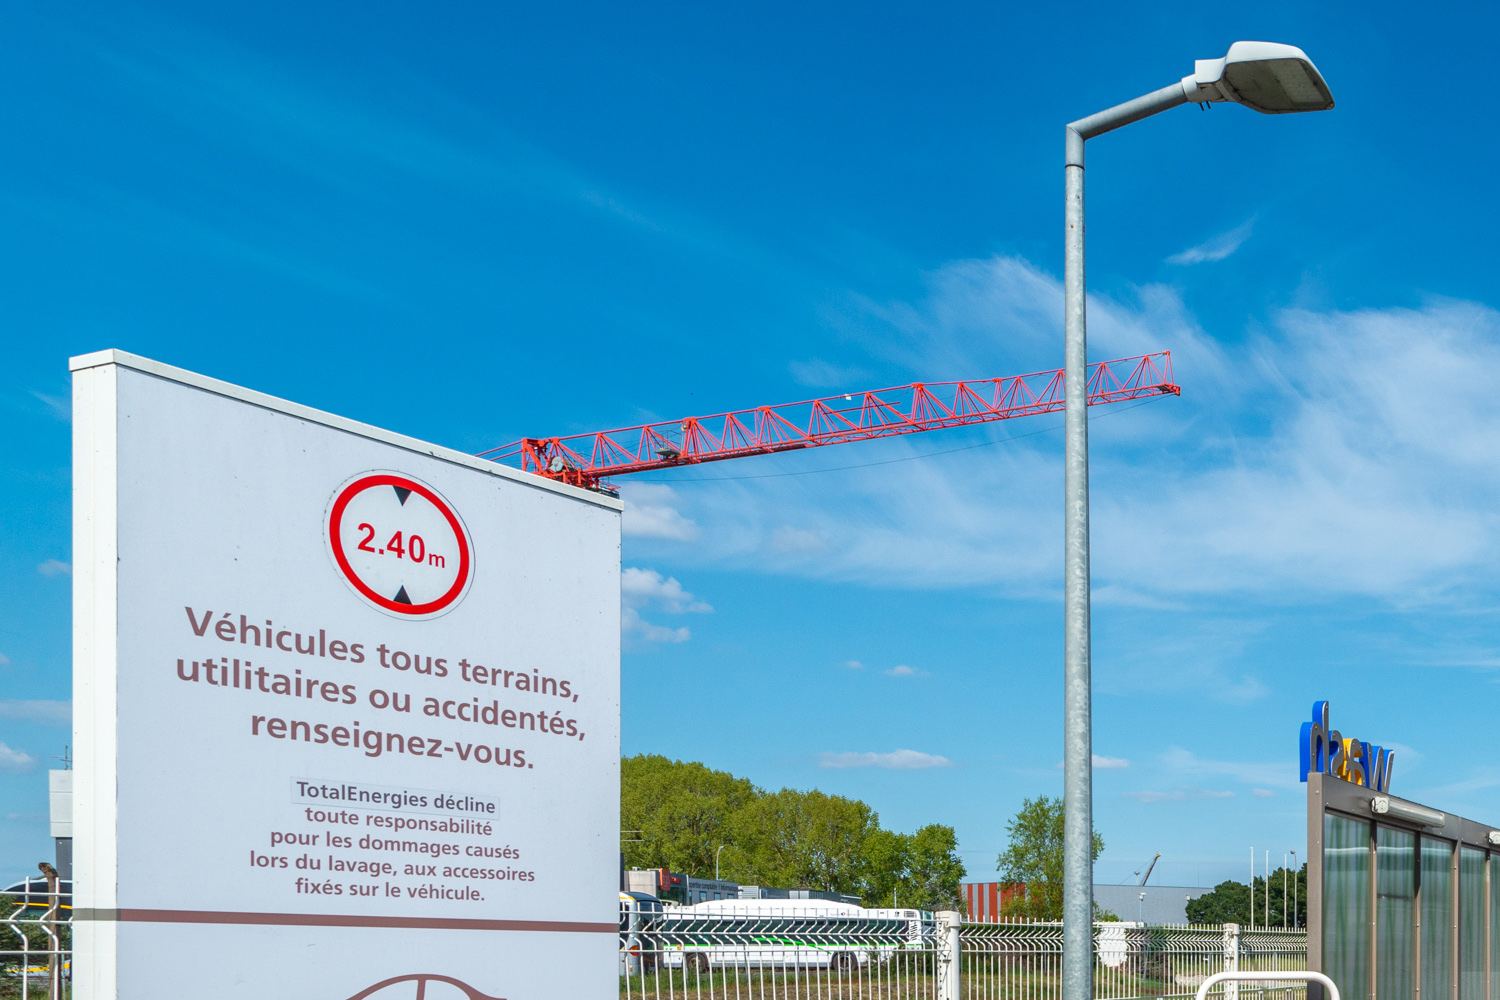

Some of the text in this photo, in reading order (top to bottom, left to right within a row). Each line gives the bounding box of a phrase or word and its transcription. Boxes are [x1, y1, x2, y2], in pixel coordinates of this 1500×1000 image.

[357, 523, 445, 569] 2.40m
[185, 606, 580, 701] Véhicules tous terrains,
[177, 658, 585, 741] utilitaires ou accidentés,
[252, 714, 533, 769] renseignez-vous.
[297, 781, 495, 814] TotalEnergies décline
[305, 807, 492, 836] toute responsabilité
[270, 830, 520, 859] pour les dommages causés
[250, 851, 535, 882] lors du lavage, aux accessoires
[295, 878, 485, 901] fixés sur le véhicule.
